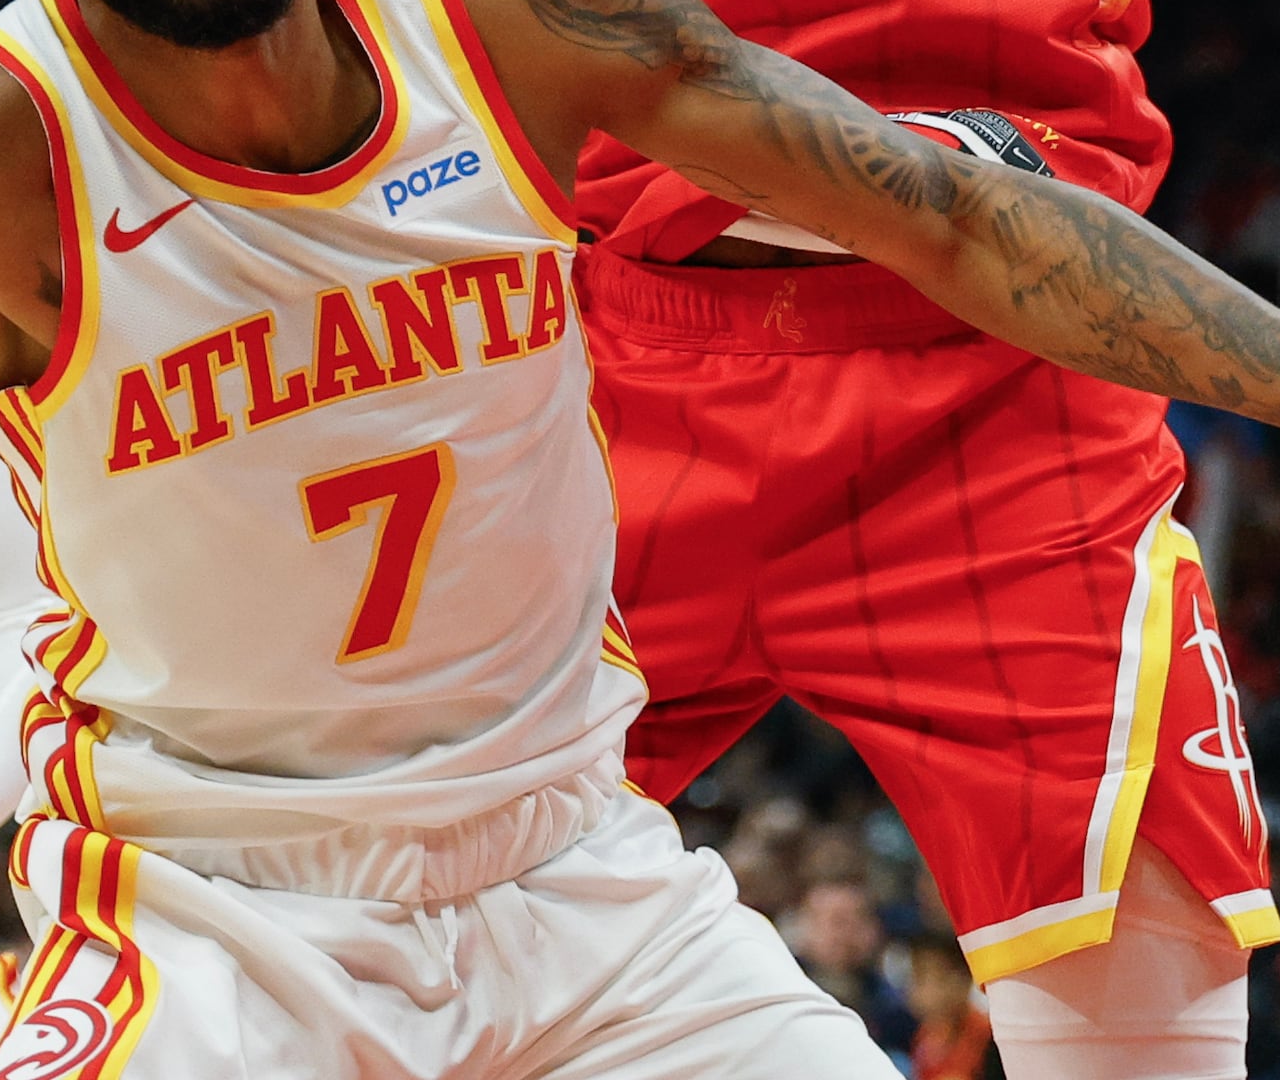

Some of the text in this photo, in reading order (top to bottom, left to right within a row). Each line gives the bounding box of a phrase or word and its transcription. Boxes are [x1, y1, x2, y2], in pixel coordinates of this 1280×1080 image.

[381, 150, 480, 217] paze
[104, 250, 567, 477] ATLANTA
[298, 441, 457, 665] 7
